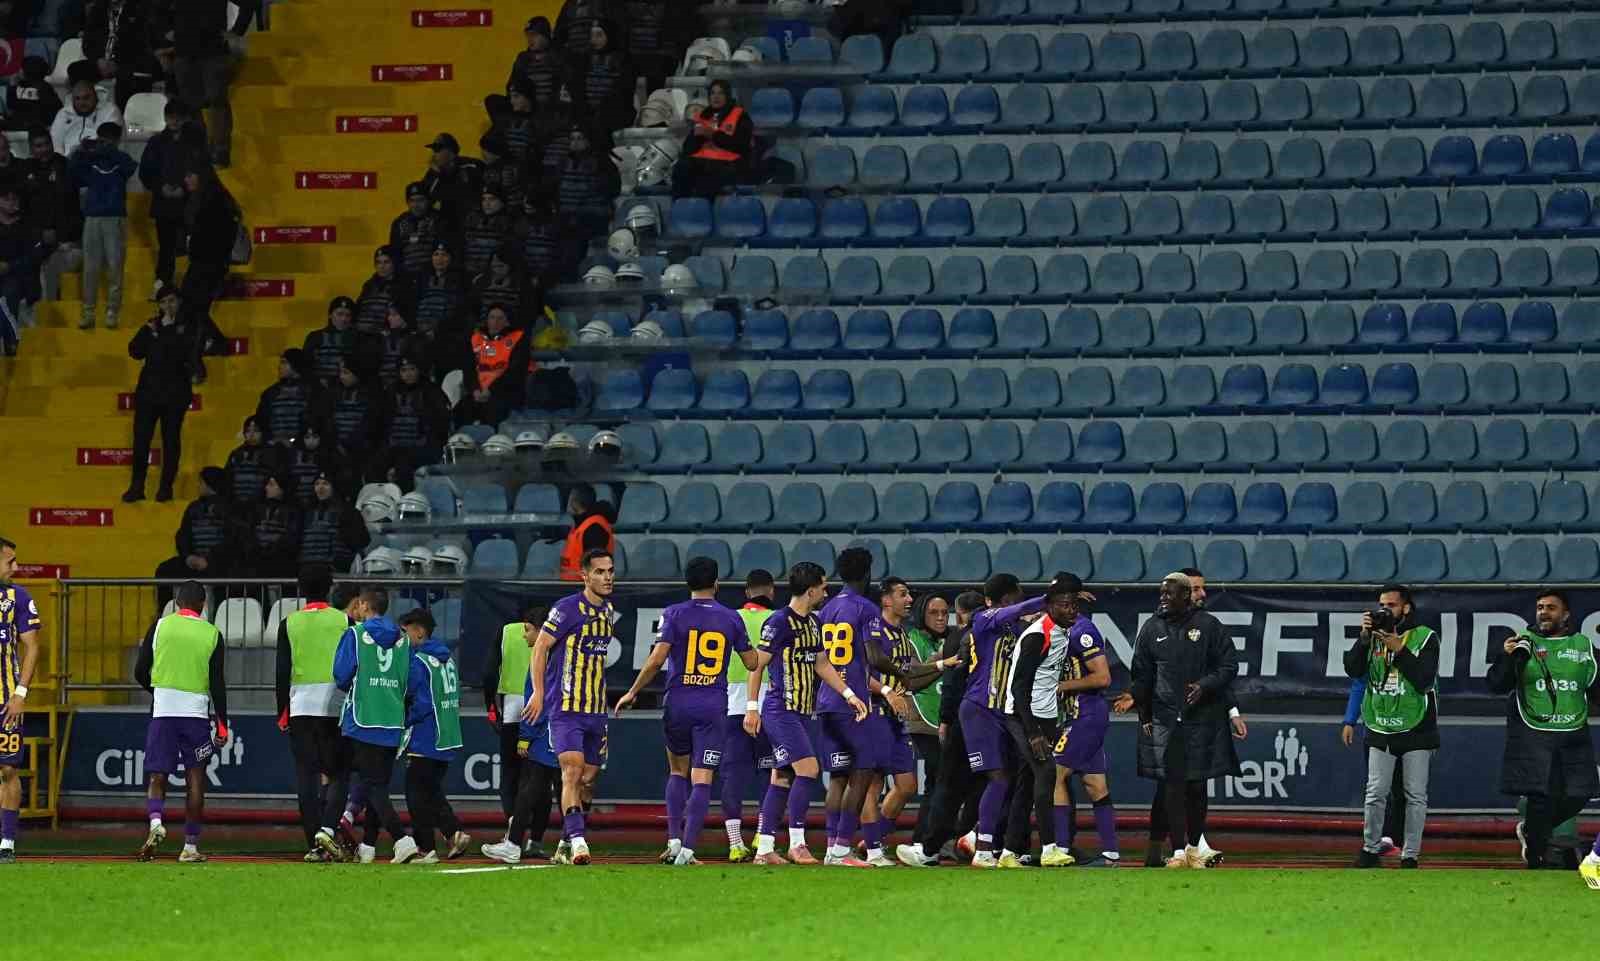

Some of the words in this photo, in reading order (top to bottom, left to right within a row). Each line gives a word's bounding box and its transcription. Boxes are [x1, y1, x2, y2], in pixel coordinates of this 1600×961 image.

[377, 645, 393, 673] 9
[685, 630, 726, 675] 19
[0, 733, 20, 753] 28
